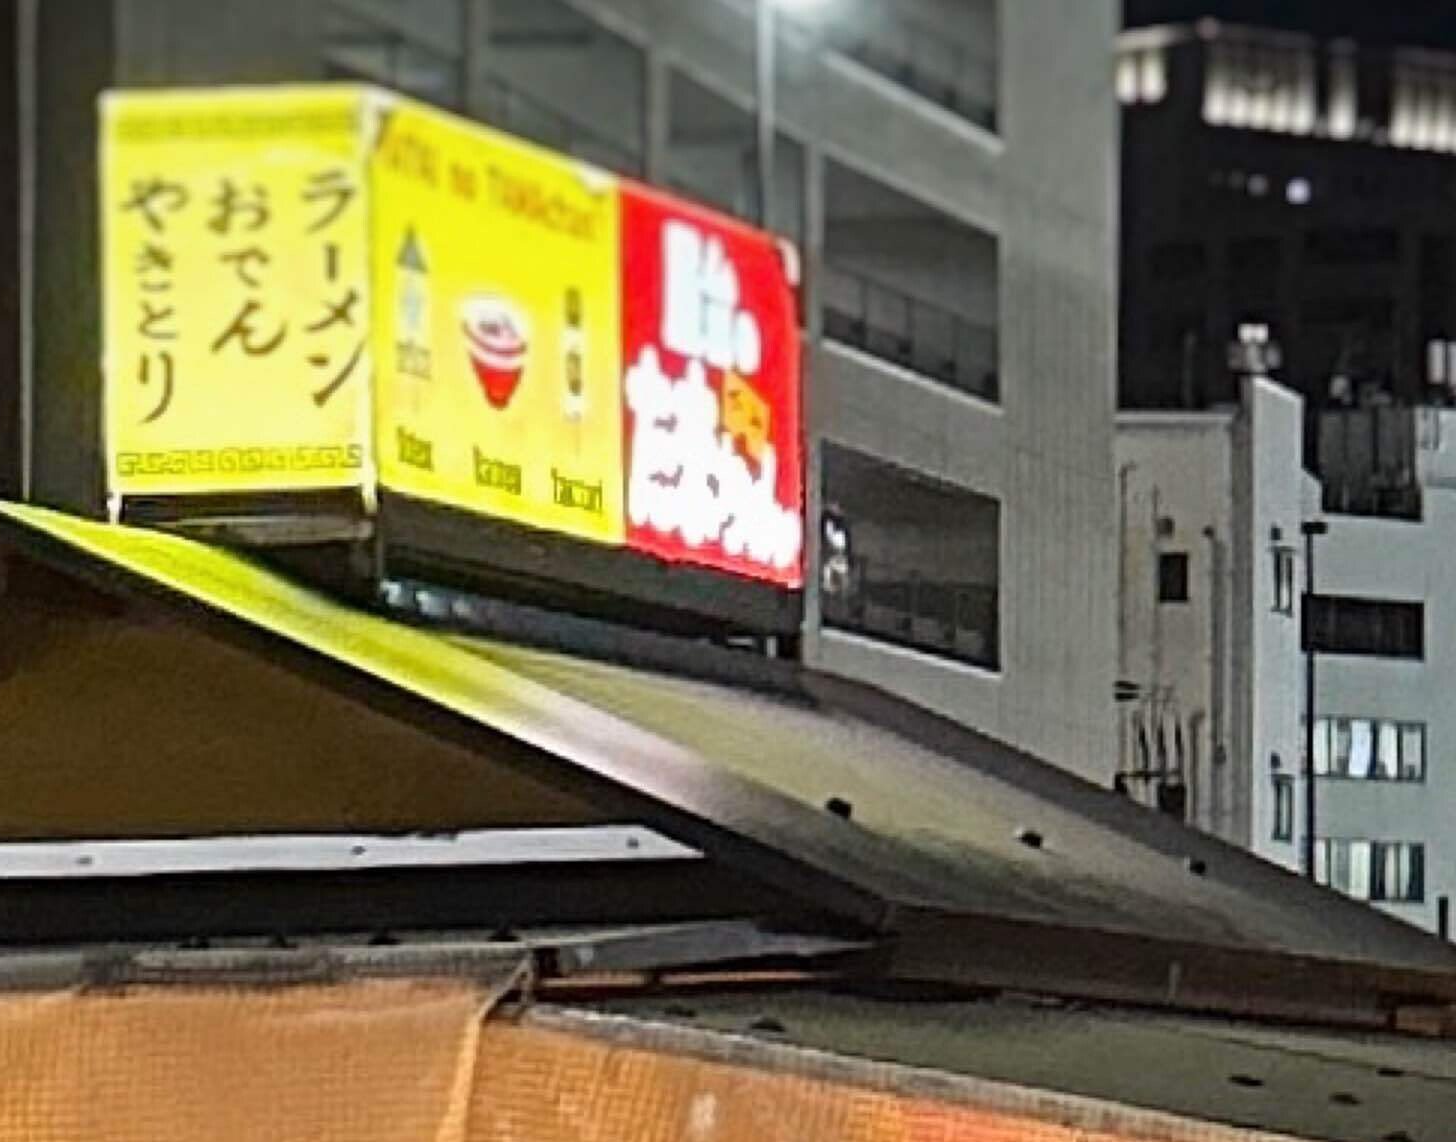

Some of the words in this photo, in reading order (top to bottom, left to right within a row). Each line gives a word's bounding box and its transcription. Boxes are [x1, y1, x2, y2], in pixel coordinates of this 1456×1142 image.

[119, 176, 192, 425] やきとり
[206, 176, 288, 357] おでん
[300, 168, 367, 408] ラーメン
